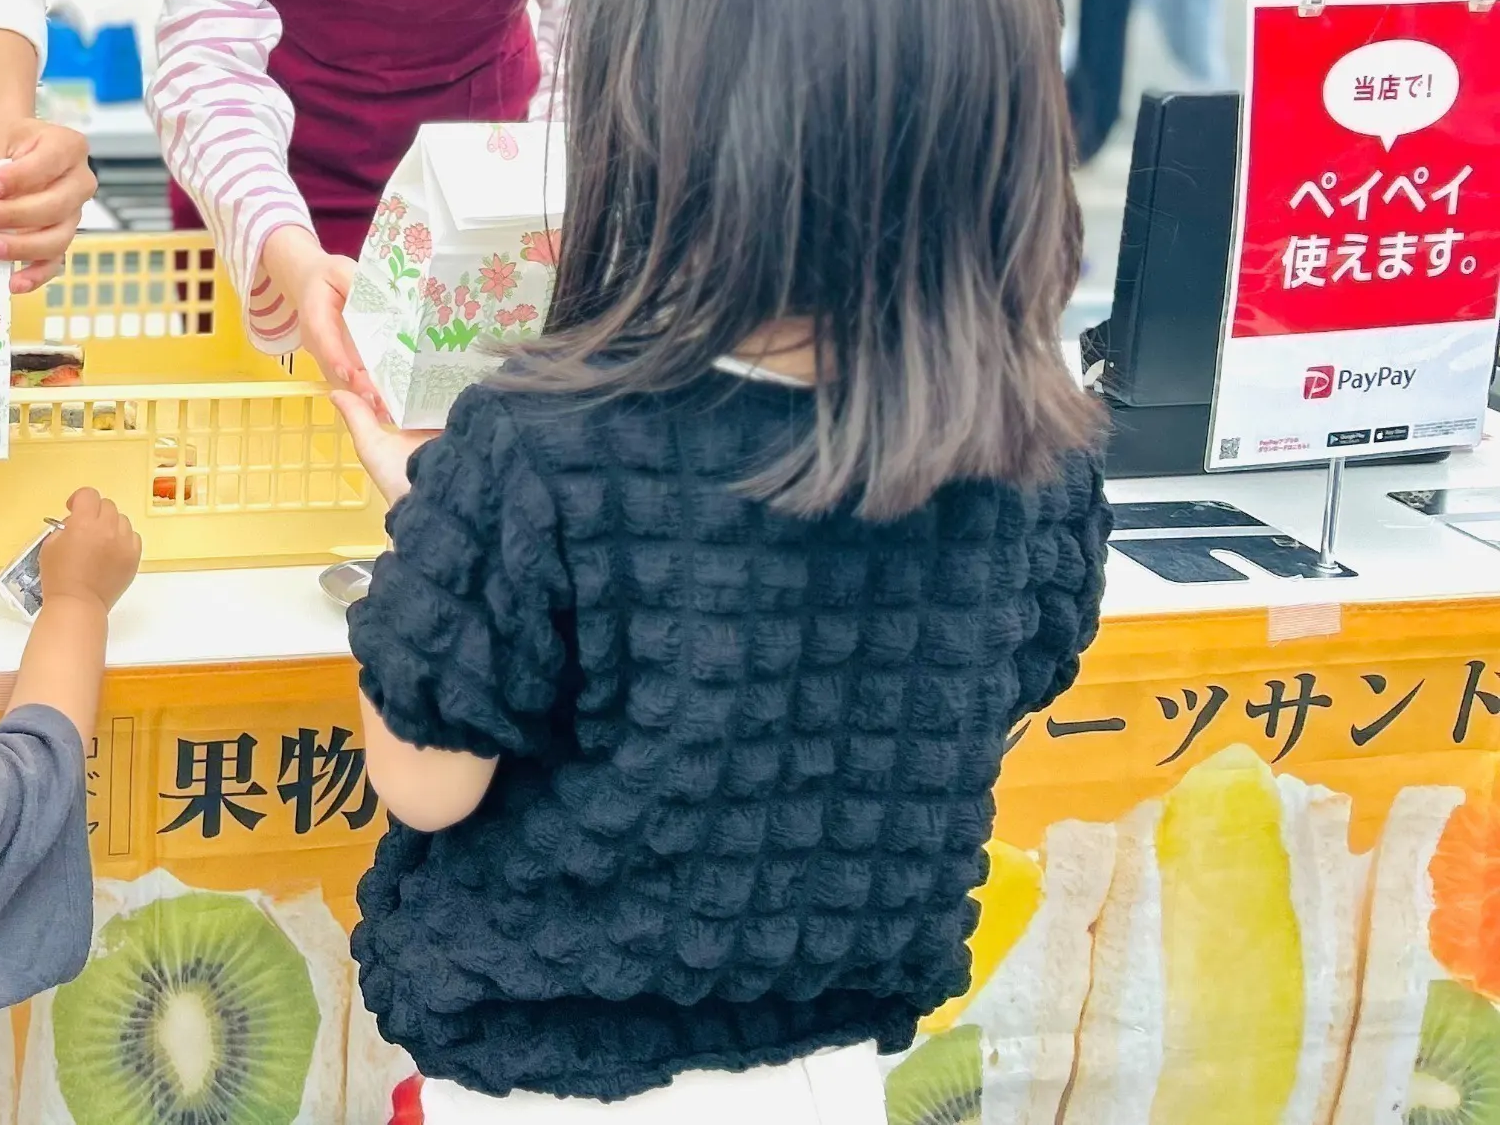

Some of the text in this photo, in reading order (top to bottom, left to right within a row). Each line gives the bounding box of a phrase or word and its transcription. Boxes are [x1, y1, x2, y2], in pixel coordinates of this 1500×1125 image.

[1353, 74, 1433, 101] 当店で!
[1288, 164, 1473, 221] ペイペイ
[1281, 227, 1477, 290] 使えます。
[1338, 366, 1417, 392] PayPay
[1002, 660, 1500, 766] ーツサンド
